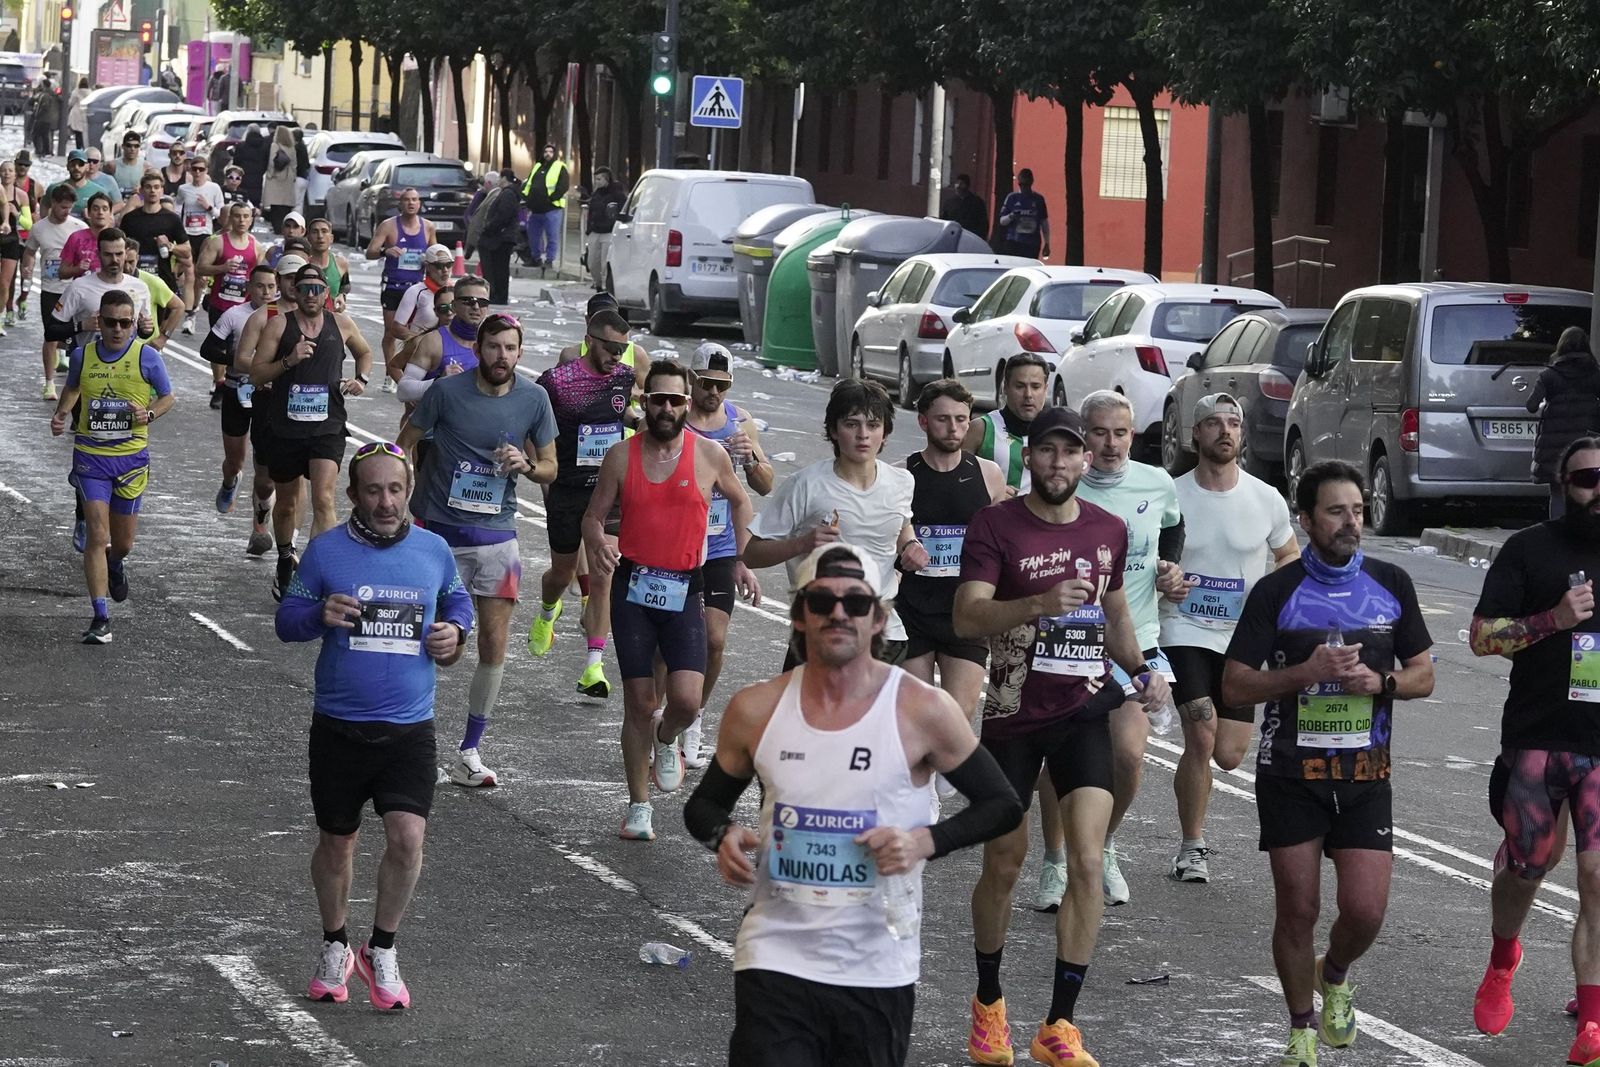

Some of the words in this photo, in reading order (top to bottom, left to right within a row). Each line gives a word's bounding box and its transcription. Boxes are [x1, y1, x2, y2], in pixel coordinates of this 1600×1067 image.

[288, 404, 327, 412] MARTINEZ
[1492, 423, 1523, 434] 5865
[474, 466, 494, 474] ZURI
[461, 488, 493, 501] MINUS
[934, 528, 966, 536] ZURICH
[928, 556, 940, 565] HN
[1204, 580, 1237, 589] ZURICH
[378, 589, 418, 600] ZURICH
[644, 593, 667, 607] CAO
[377, 609, 400, 619] 3607
[1190, 603, 1230, 618] DANIËL
[362, 621, 414, 637] MORTIS
[1065, 629, 1086, 640] 5303
[1035, 642, 1049, 656] D.
[1053, 641, 1104, 660] VÁZQUEZ
[1571, 679, 1598, 688] PABLO
[1325, 704, 1348, 713] 2674
[1299, 720, 1352, 732] ROBERTO
[1356, 719, 1371, 730] CID
[804, 813, 864, 829] ZURICH
[806, 842, 837, 856] 7343
[778, 857, 868, 883] NUNOLAS
